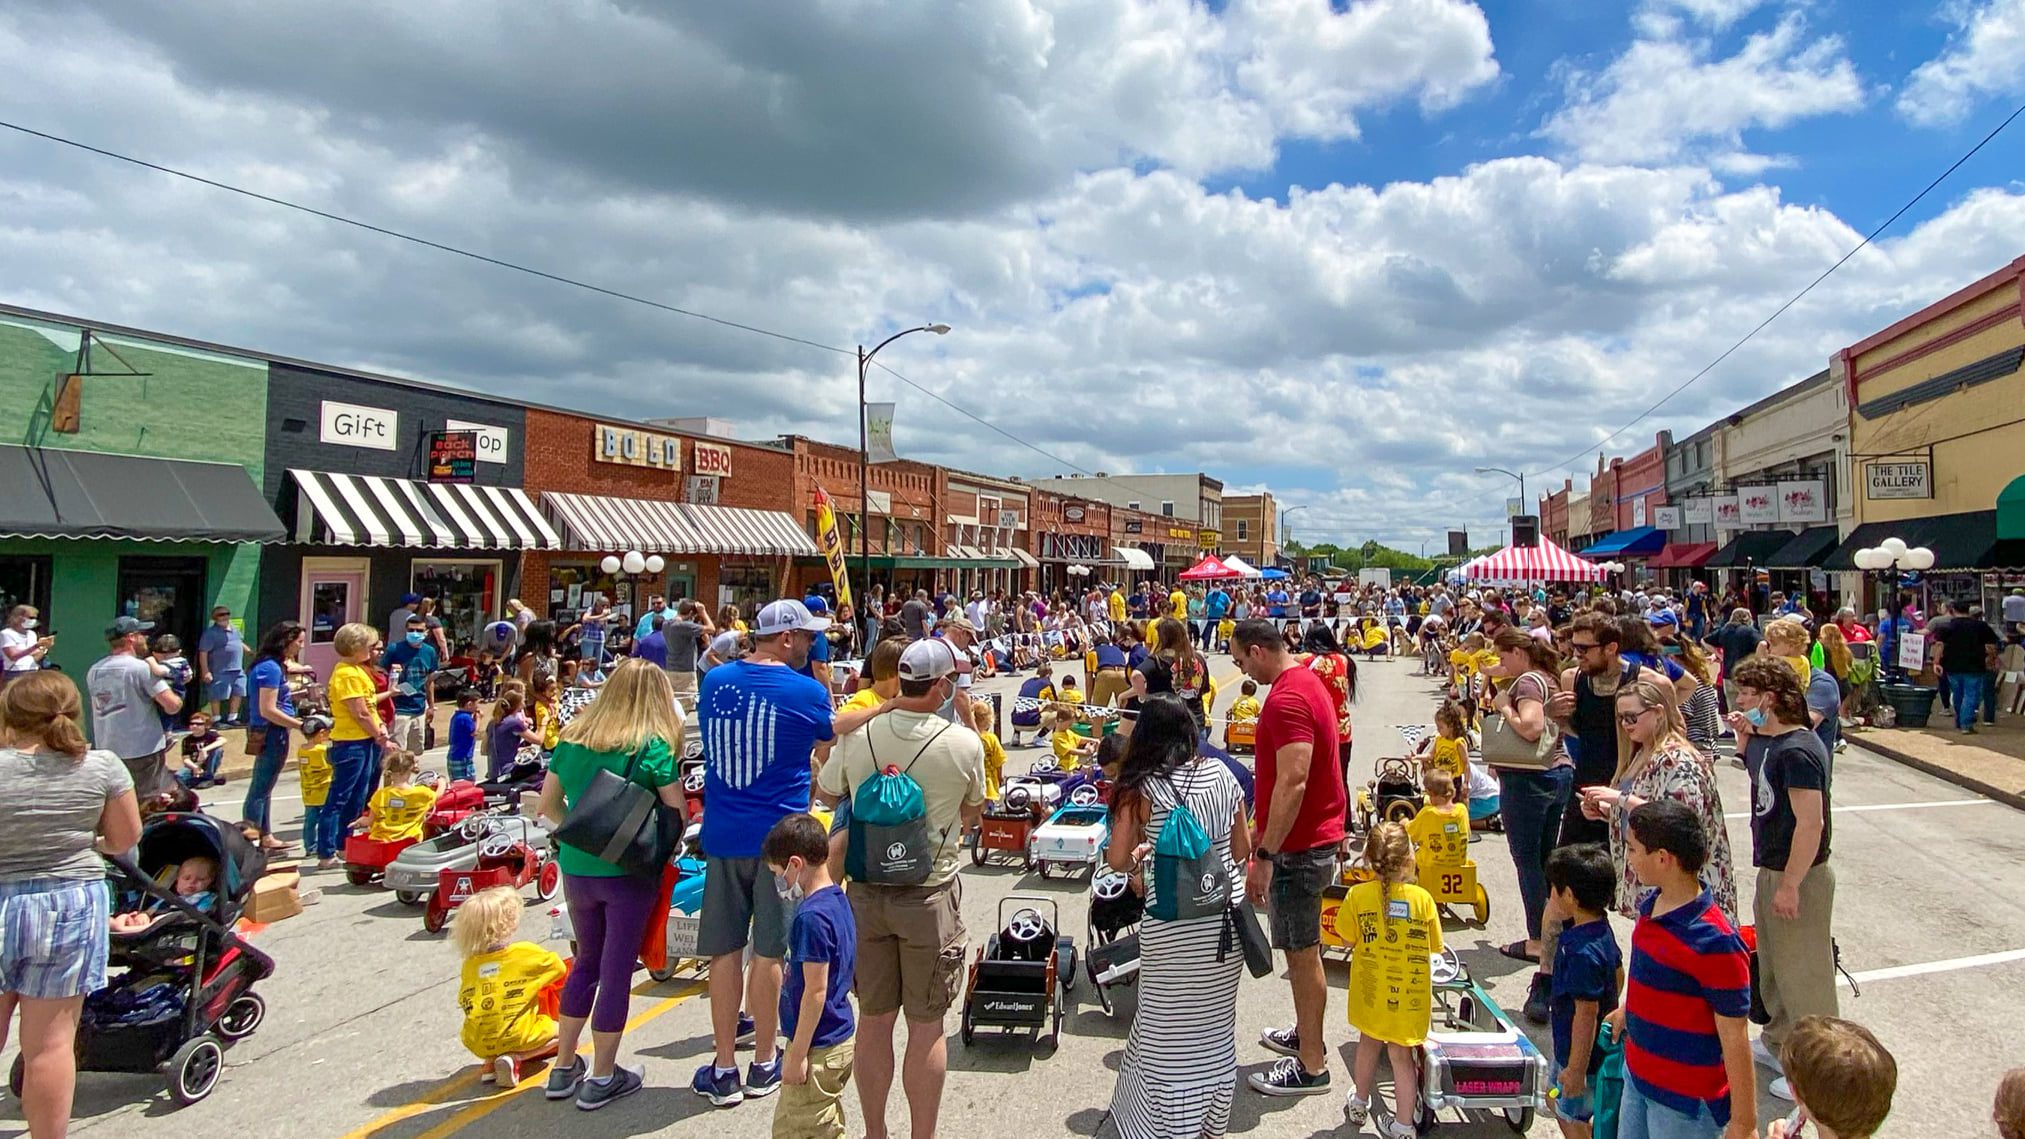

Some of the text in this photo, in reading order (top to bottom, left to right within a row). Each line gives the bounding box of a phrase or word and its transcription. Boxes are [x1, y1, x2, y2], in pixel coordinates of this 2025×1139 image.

[334, 413, 385, 438] Gift
[479, 435, 502, 454] op
[603, 427, 676, 465] BOLD
[698, 447, 730, 474] BBQ
[1873, 464, 1922, 476] THE TILE
[1873, 476, 1923, 488] GALLERY
[1441, 874, 1463, 894] 32
[1456, 1081, 1520, 1094] LASER WRAPS
